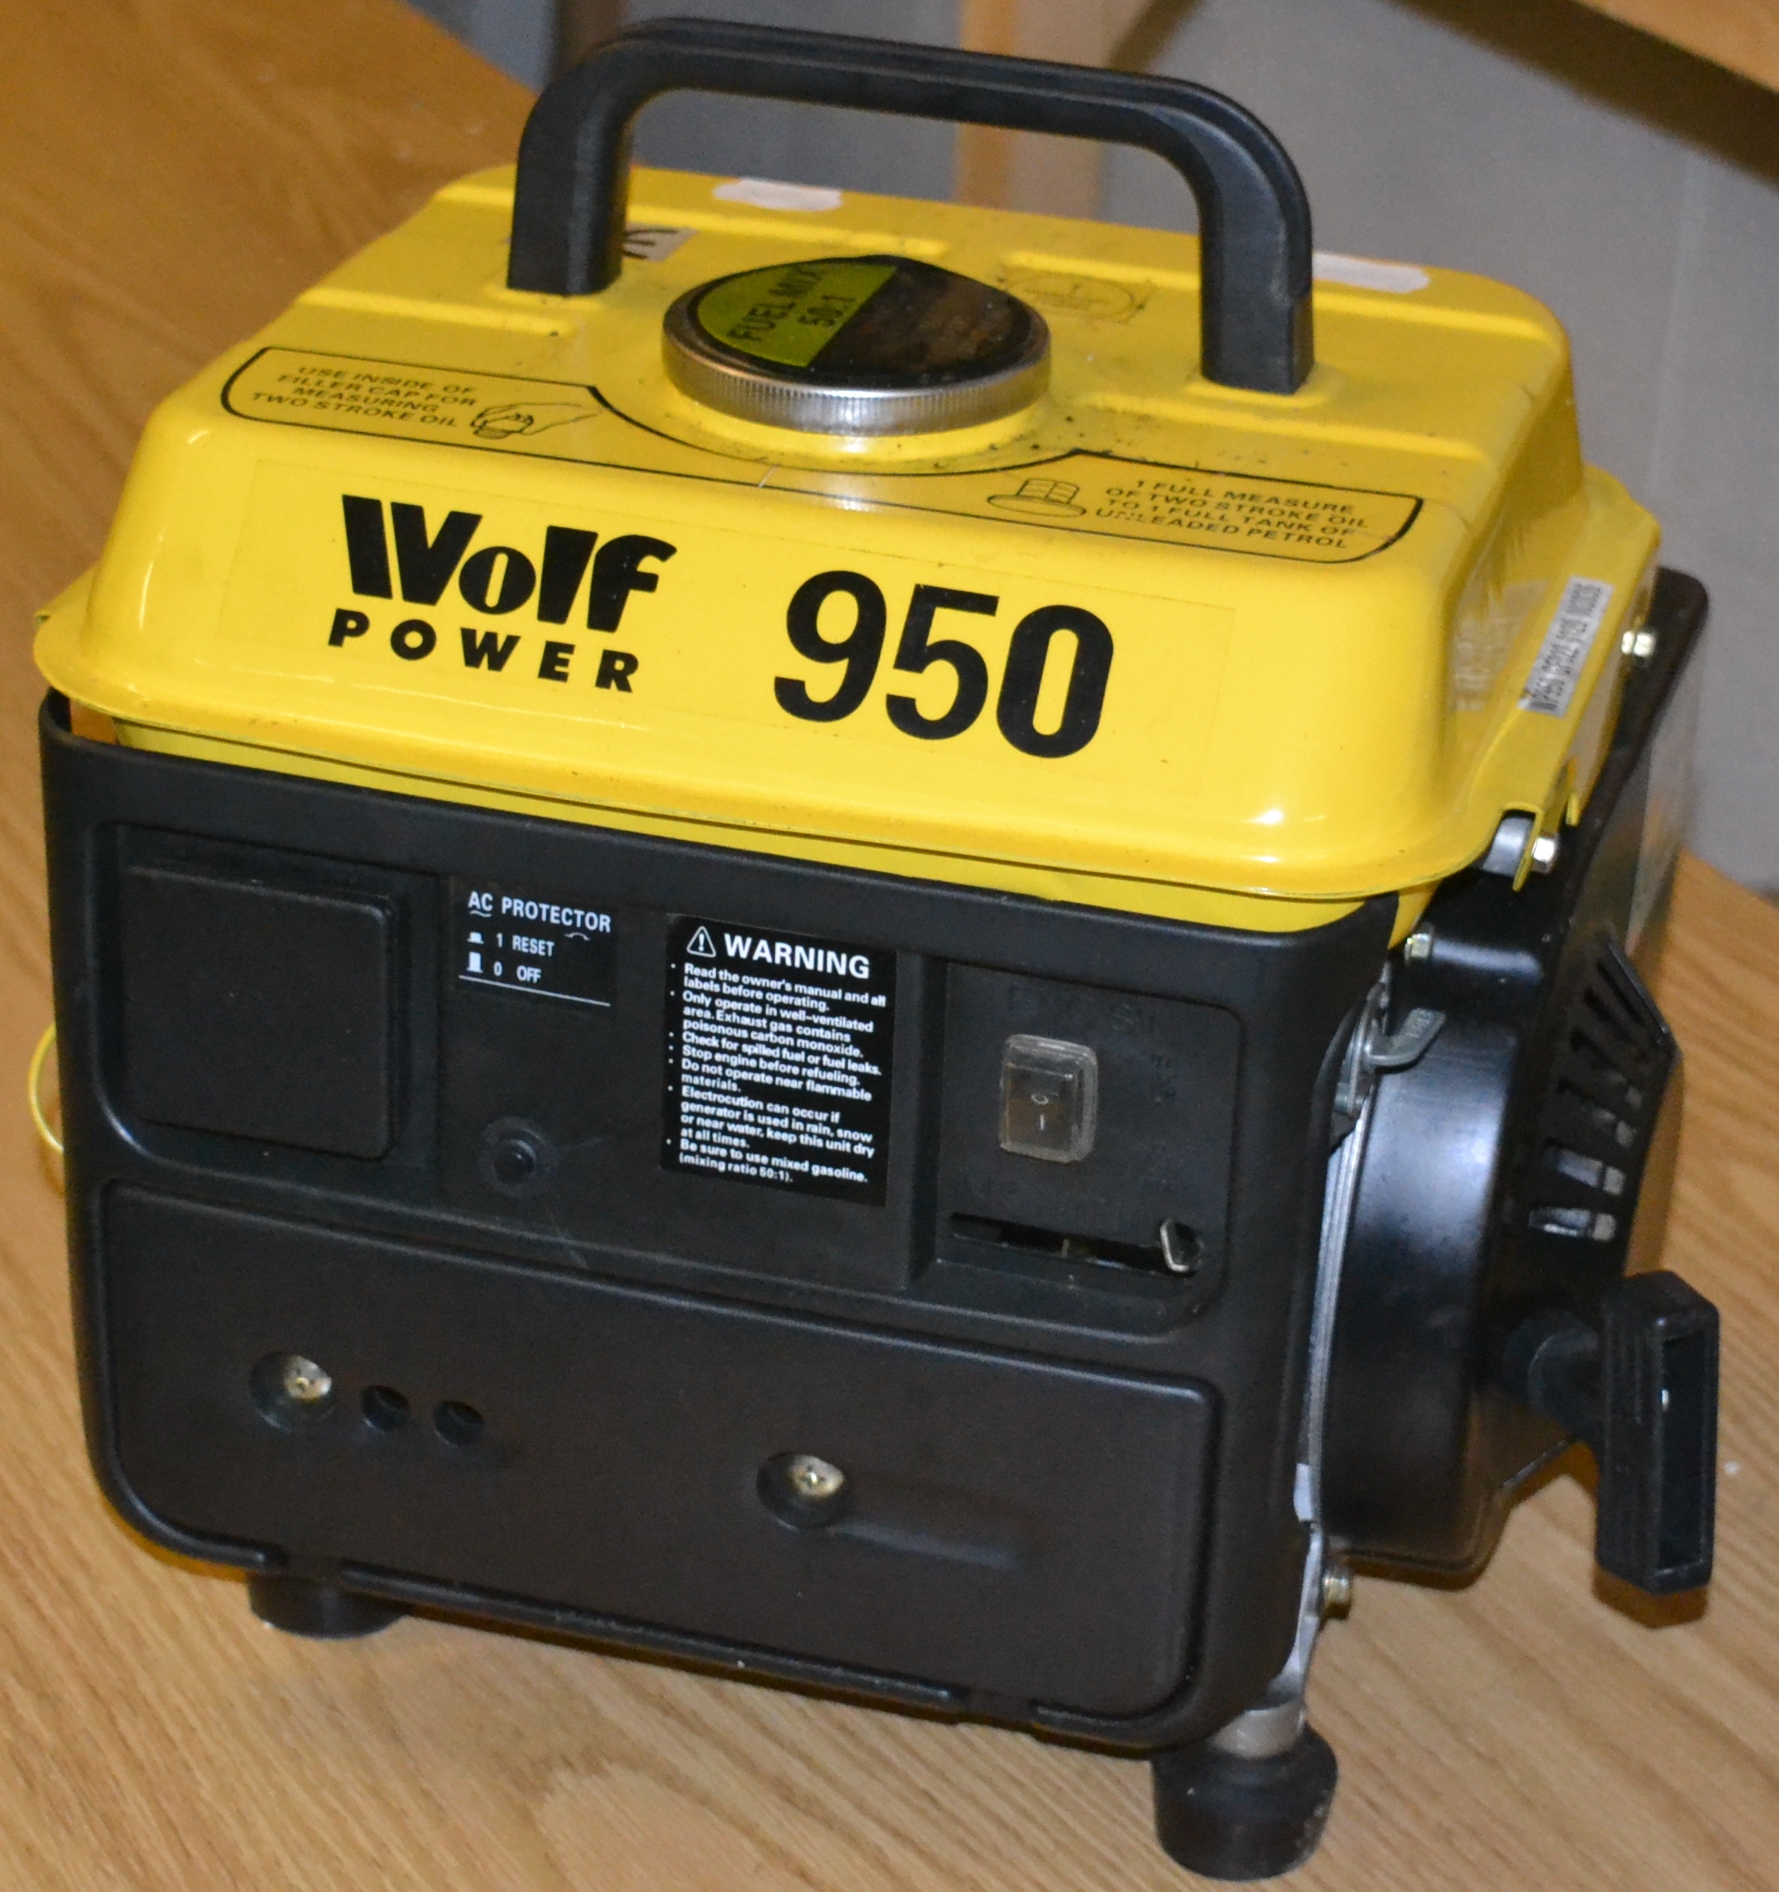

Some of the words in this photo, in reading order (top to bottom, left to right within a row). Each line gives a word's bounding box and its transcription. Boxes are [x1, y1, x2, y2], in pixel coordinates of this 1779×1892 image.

[727, 301, 797, 342] FUEL
[276, 373, 362, 392] FILLER
[368, 385, 420, 398] CAP
[425, 392, 479, 407] FOR
[293, 386, 441, 413] MEASURING
[299, 366, 347, 379] USE
[353, 372, 436, 391] INSIDE
[443, 384, 479, 395] OF
[251, 391, 308, 408] TWO
[314, 400, 415, 422] STROKE
[419, 413, 459, 428] OIL
[1105, 487, 1141, 499] OF
[1150, 492, 1209, 508] TWO
[1213, 501, 1322, 524] STROKE
[1327, 514, 1369, 530] OIL
[1106, 498, 1140, 511] TO
[1167, 506, 1231, 524] FULL
[1242, 514, 1317, 533] TANK
[1320, 525, 1357, 537] OF
[1152, 481, 1215, 499] FULL
[1223, 490, 1355, 515] MEASURE
[1095, 508, 1241, 535] UNLEADED
[1246, 528, 1349, 549] PETROL
[340, 493, 677, 634] Wolf
[327, 609, 639, 694] POWER
[773, 569, 1114, 759] 950
[468, 890, 493, 912] AC
[501, 896, 611, 934] PROTECTOR
[496, 932, 503, 948] 1
[512, 934, 555, 958] RESET
[723, 933, 870, 979] WARNING
[516, 965, 542, 983] OFF
[684, 962, 717, 979] Read
[718, 969, 740, 983] the
[741, 974, 793, 992] owner's
[794, 983, 843, 1000] manual
[844, 992, 869, 1004] and
[870, 994, 887, 1007] all
[684, 975, 721, 993] labels
[722, 981, 763, 1000] before
[765, 991, 830, 1013] operating.
[682, 990, 712, 1008] Only
[714, 998, 763, 1015] operate
[765, 1004, 777, 1016] in
[779, 1008, 874, 1033] well-ventilated
[683, 1006, 715, 1020] area.
[716, 1009, 767, 1029] Exhaust
[769, 1021, 793, 1033] gas
[795, 1024, 851, 1043] contains
[682, 1030, 719, 1048] Check
[721, 1037, 740, 1051] for
[741, 1043, 780, 1059] spilled
[781, 1047, 805, 1063] fuel
[806, 1054, 822, 1065] or
[822, 1053, 846, 1070] fuel
[847, 1058, 882, 1076] leaks.
[683, 1019, 749, 1039] poisonous
[750, 1030, 794, 1047] carbon
[796, 1037, 864, 1059] monoxide.
[681, 1057, 700, 1072] Do
[701, 1063, 724, 1076] not
[724, 1068, 774, 1085] operate
[774, 1076, 804, 1090] near
[805, 1079, 873, 1102] flammable
[681, 1073, 742, 1093] materials.
[682, 1044, 713, 1062] Stop
[714, 1052, 758, 1069] engine
[758, 1057, 800, 1075] before
[801, 1065, 861, 1087] refueling.
[680, 1101, 742, 1120] generator
[743, 1109, 755, 1123] is
[757, 1114, 789, 1129] used
[791, 1117, 804, 1132] in
[806, 1122, 835, 1138] rain,
[836, 1127, 874, 1143] snow
[681, 1084, 764, 1111] Electrocution
[766, 1102, 790, 1115] can
[791, 1106, 829, 1122] occur
[830, 1110, 841, 1124] if
[680, 1114, 695, 1125] or
[696, 1116, 725, 1131] near
[766, 1126, 798, 1145] keep
[799, 1132, 824, 1148] this
[825, 1138, 852, 1154] unit
[853, 1142, 876, 1159] dry
[680, 1127, 694, 1139] at
[695, 1128, 711, 1141] all
[711, 1131, 750, 1149] times.
[679, 1151, 726, 1173] (mixing
[727, 1162, 758, 1176] ratio
[758, 1165, 794, 1183] 50:1).
[680, 1137, 698, 1152] Be
[700, 1143, 728, 1158] sure
[729, 1147, 743, 1160] to
[745, 1152, 769, 1165] use
[771, 1155, 810, 1172] mixed
[811, 1162, 869, 1183] gasoline.
